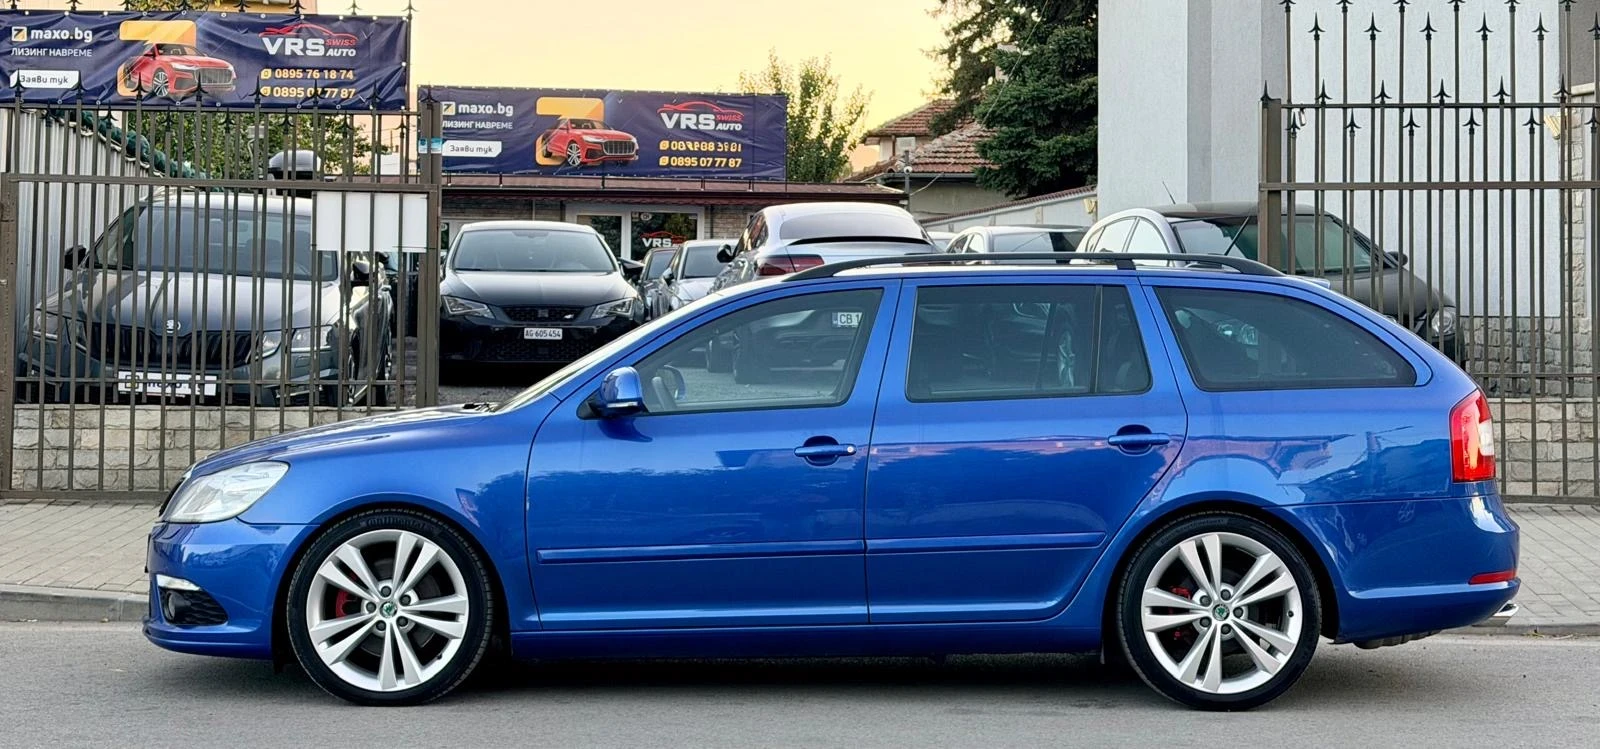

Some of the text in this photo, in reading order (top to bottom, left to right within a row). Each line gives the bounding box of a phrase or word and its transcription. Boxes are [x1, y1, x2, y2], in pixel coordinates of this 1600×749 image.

[30, 27, 93, 43] maxo.bg
[11, 47, 93, 57] ЛИЗИНГ НАВРЕМЕ
[262, 37, 325, 56] VRS
[326, 48, 357, 57] AUTO
[274, 68, 354, 79] 0895 76 18 74
[273, 86, 304, 98] 0895
[324, 87, 339, 98] 77
[340, 88, 356, 98] 87
[458, 102, 514, 117] maxo.bg
[442, 120, 514, 130] ЛИЗИНГ НАВРЕМЕ
[661, 112, 715, 130] VRS
[716, 123, 743, 131] AUTO
[670, 156, 743, 168] 0895 07 77 87
[642, 237, 672, 248] VRS
